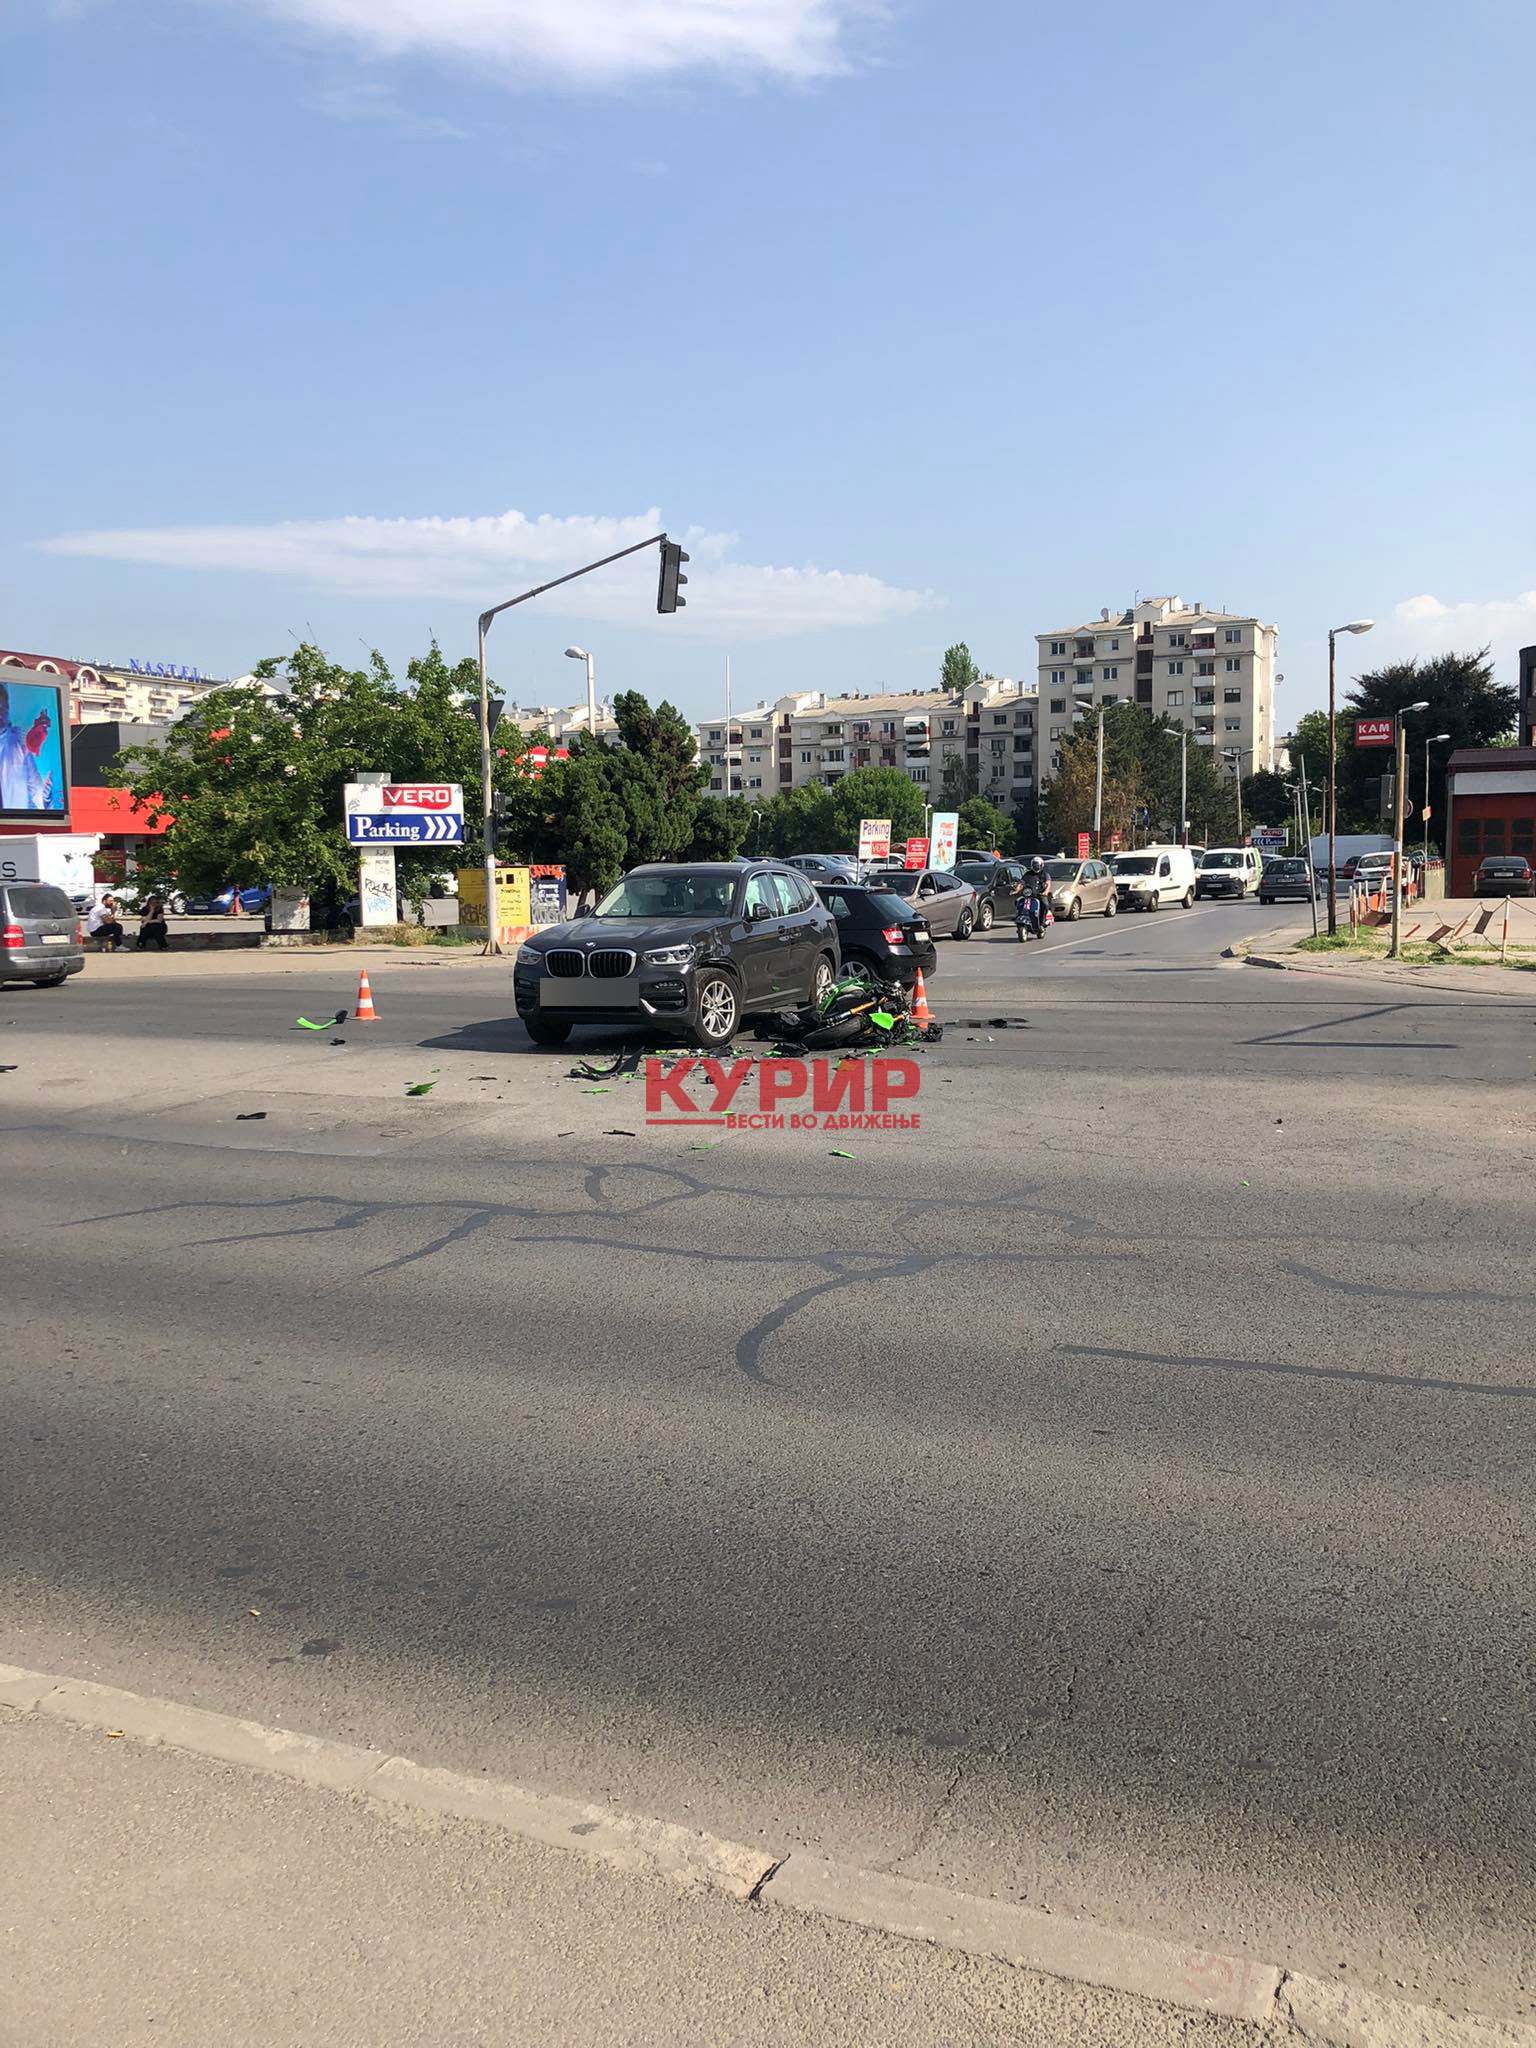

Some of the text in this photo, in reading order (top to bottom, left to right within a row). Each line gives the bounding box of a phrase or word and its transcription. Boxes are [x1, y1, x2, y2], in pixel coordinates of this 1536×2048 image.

[129, 657, 201, 682] NASTEL
[1359, 723, 1390, 734] KAM
[386, 790, 449, 803] VERO
[355, 816, 420, 840] Parking
[864, 821, 890, 839] Parking
